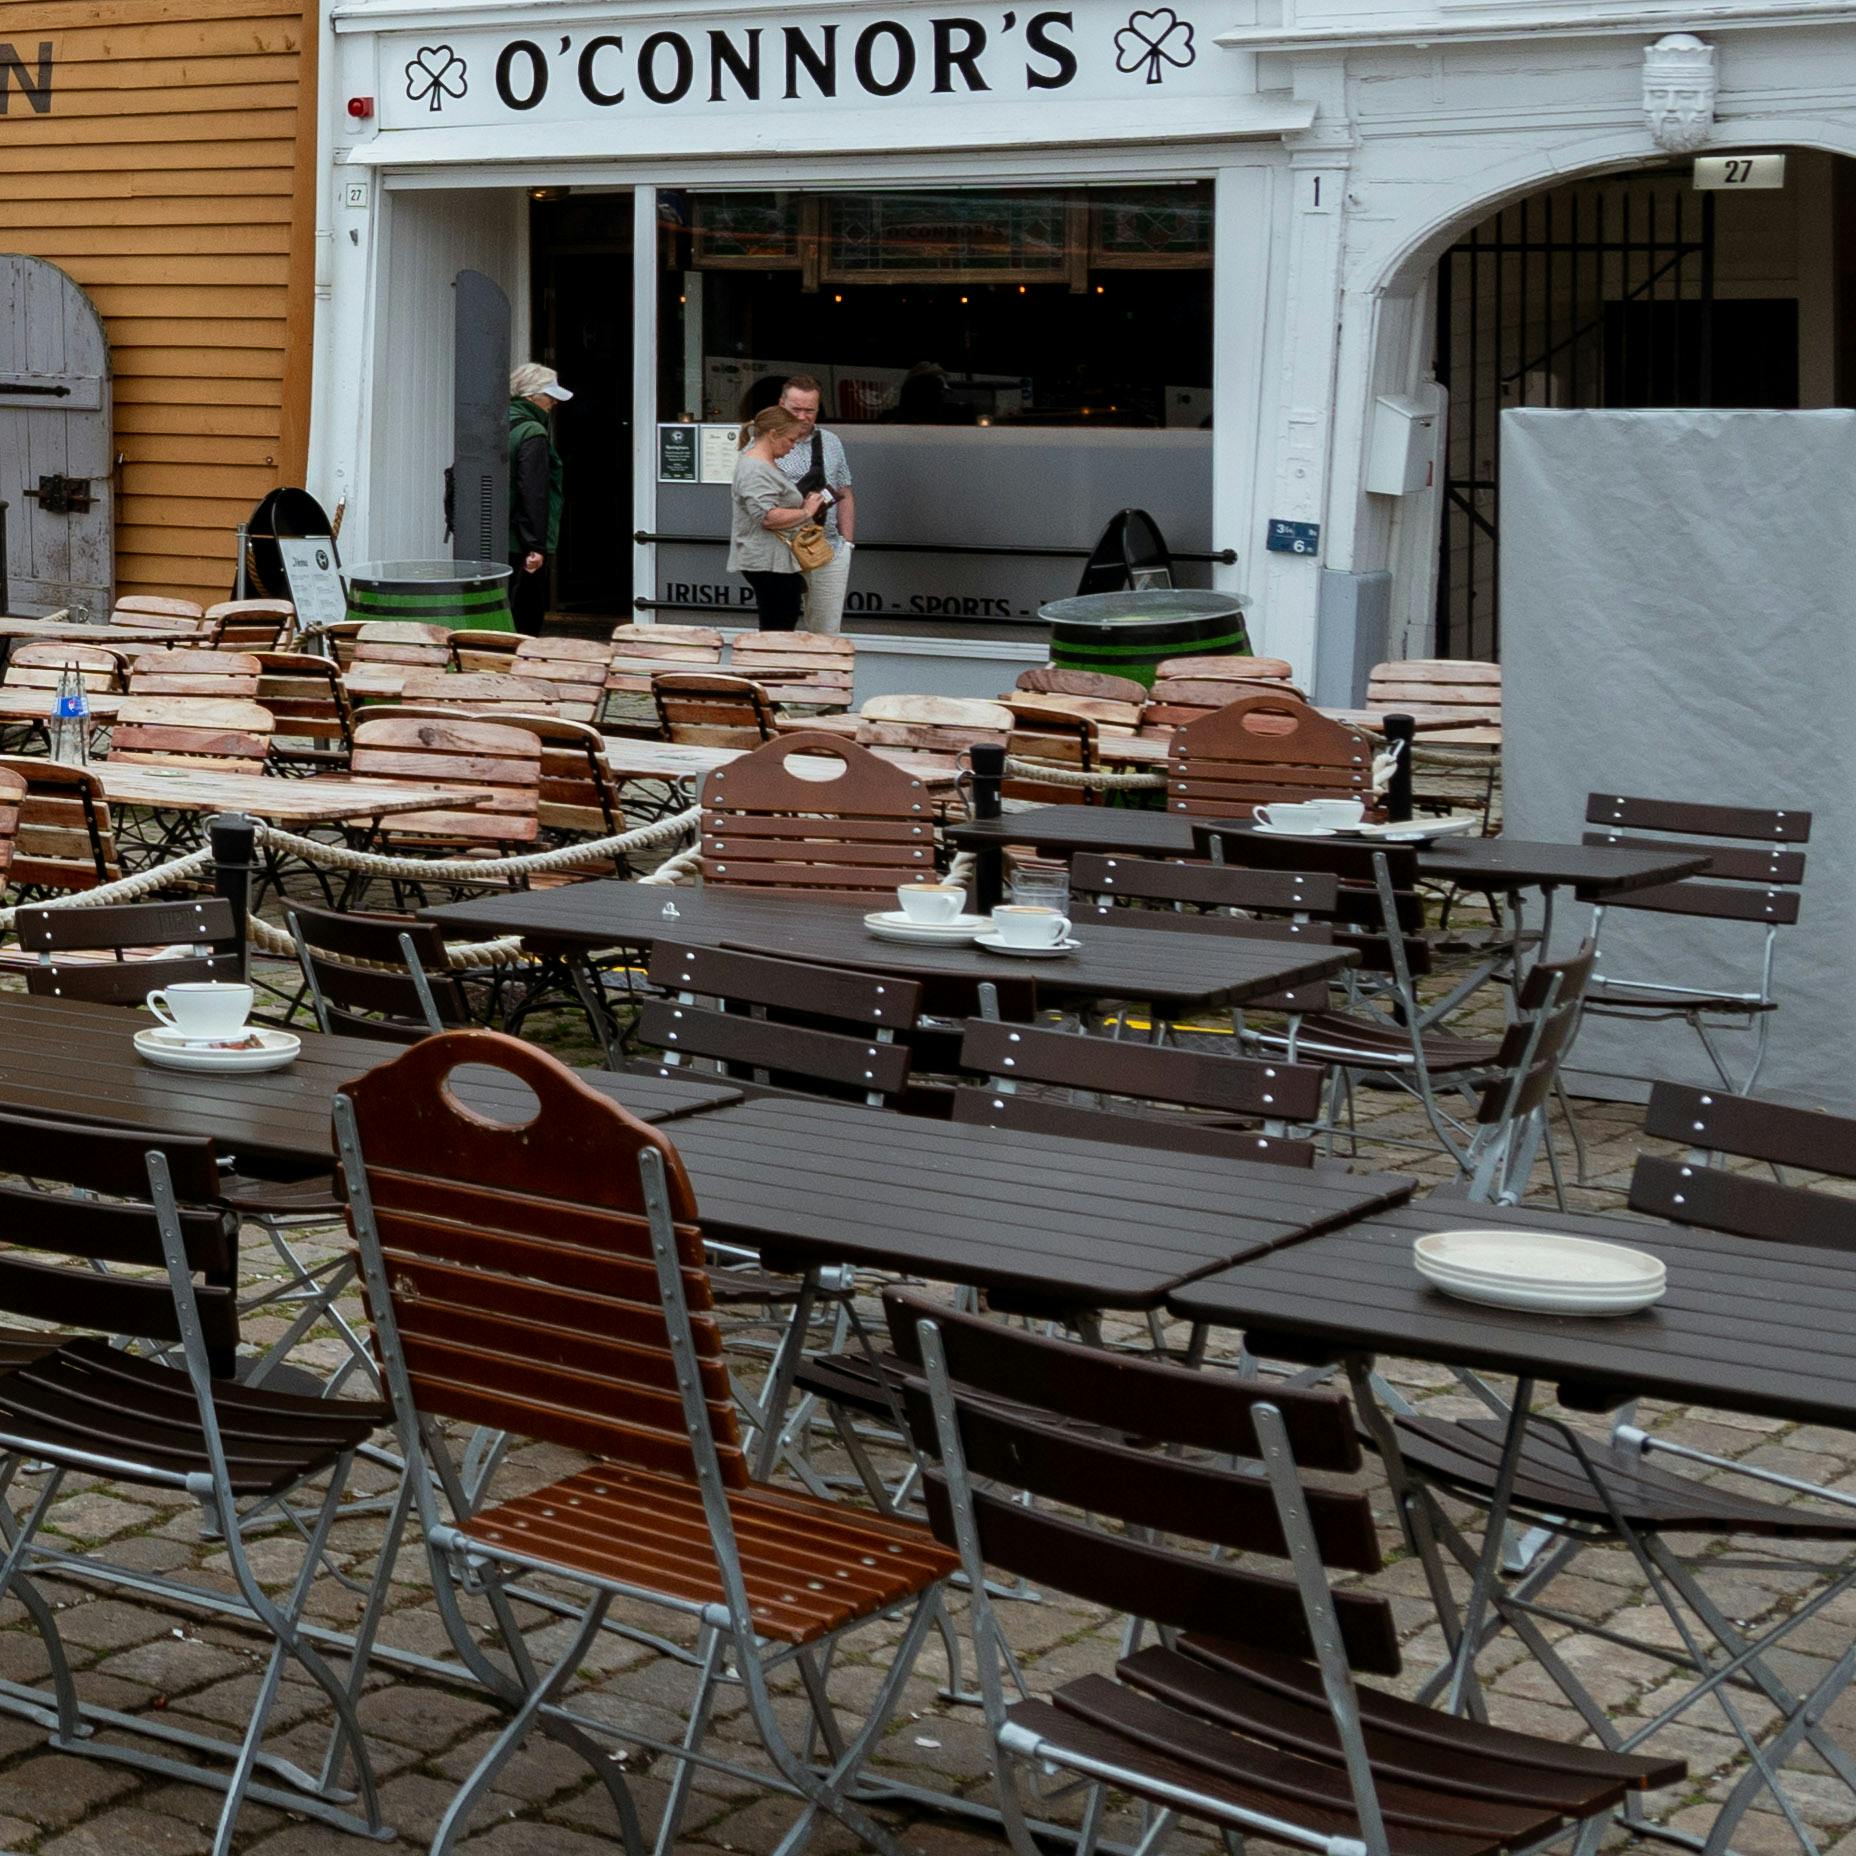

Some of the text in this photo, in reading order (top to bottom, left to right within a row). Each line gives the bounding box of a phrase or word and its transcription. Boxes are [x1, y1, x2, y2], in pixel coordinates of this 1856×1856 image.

[493, 9, 1080, 112] O'CONNOR'S
[1723, 159, 1754, 185] 27
[350, 189, 362, 201] 27
[666, 582, 730, 606] IRISH
[910, 594, 1010, 617] SPORTS
